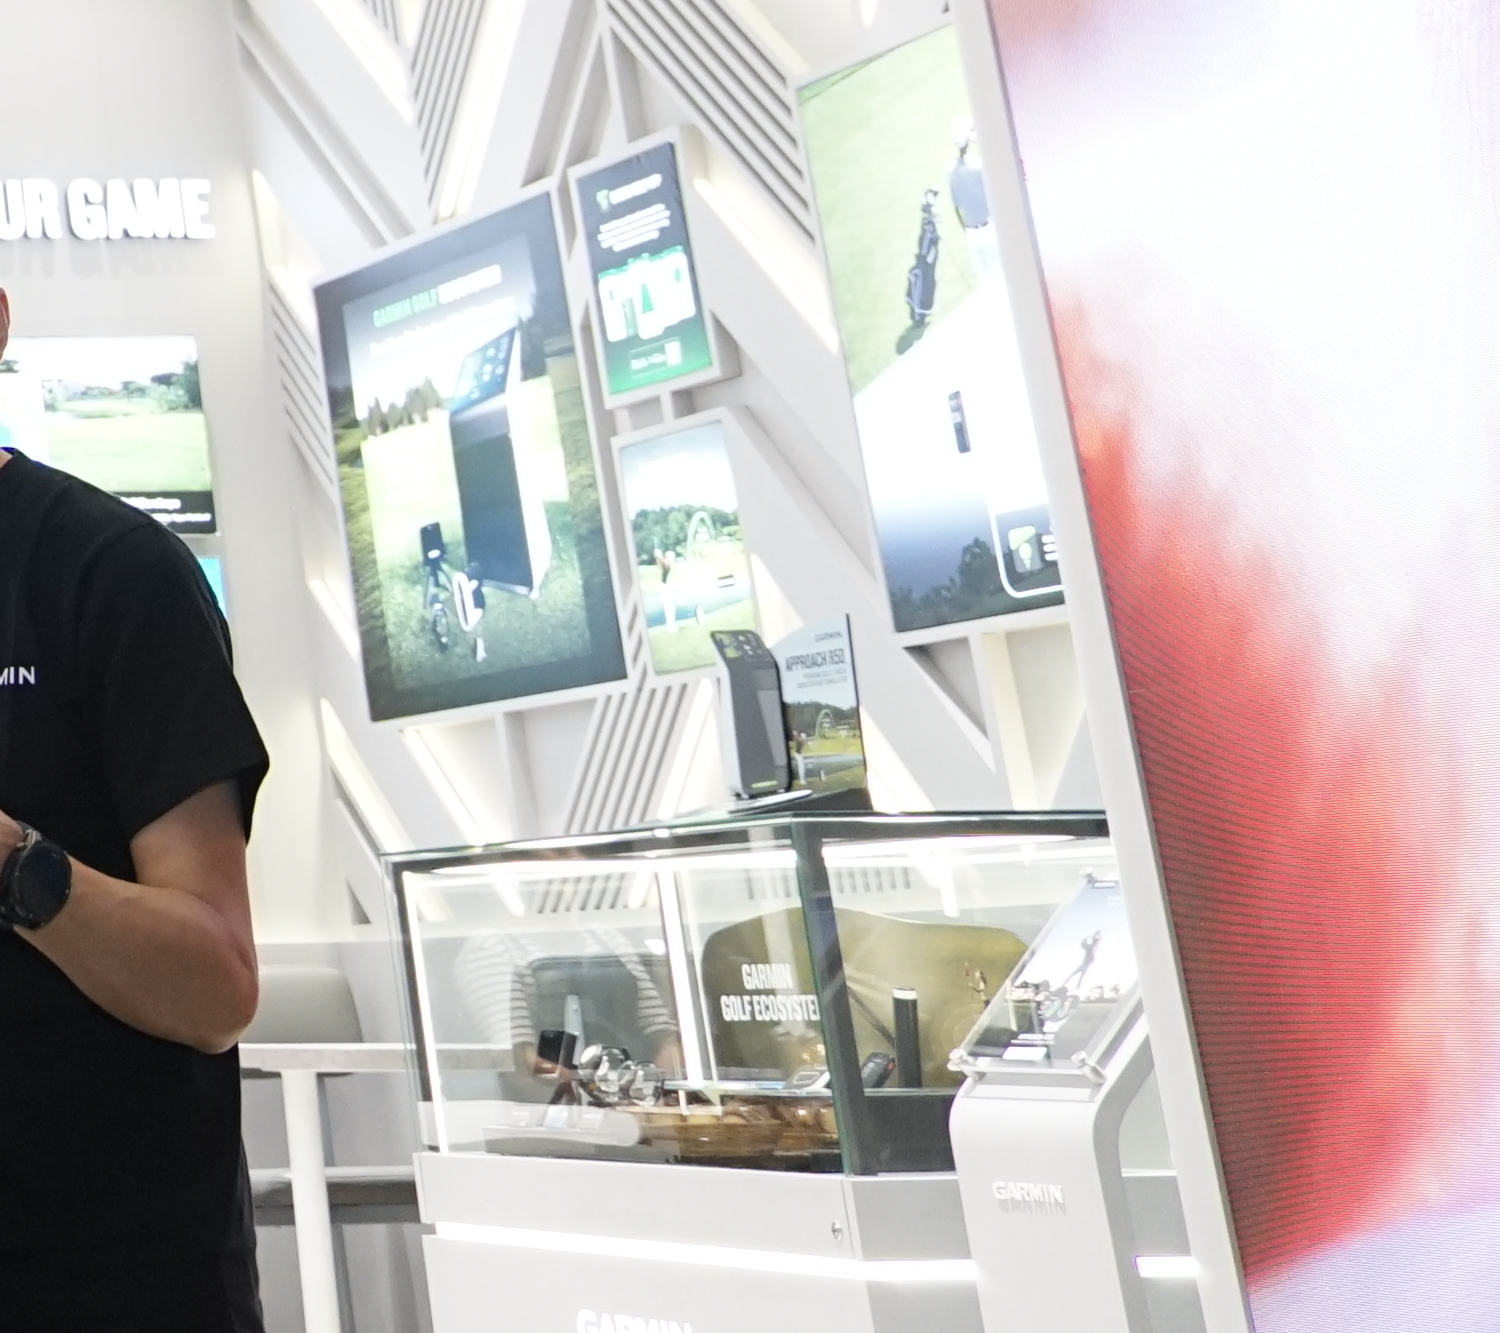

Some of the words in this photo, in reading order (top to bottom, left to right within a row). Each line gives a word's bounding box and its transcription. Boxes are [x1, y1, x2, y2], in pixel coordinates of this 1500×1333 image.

[67, 177, 217, 241] GAME
[741, 962, 794, 991] GARMIN
[720, 994, 752, 1022] GOLF
[752, 993, 820, 1022] ECOSYSTE
[991, 1180, 1065, 1204] GARMIN
